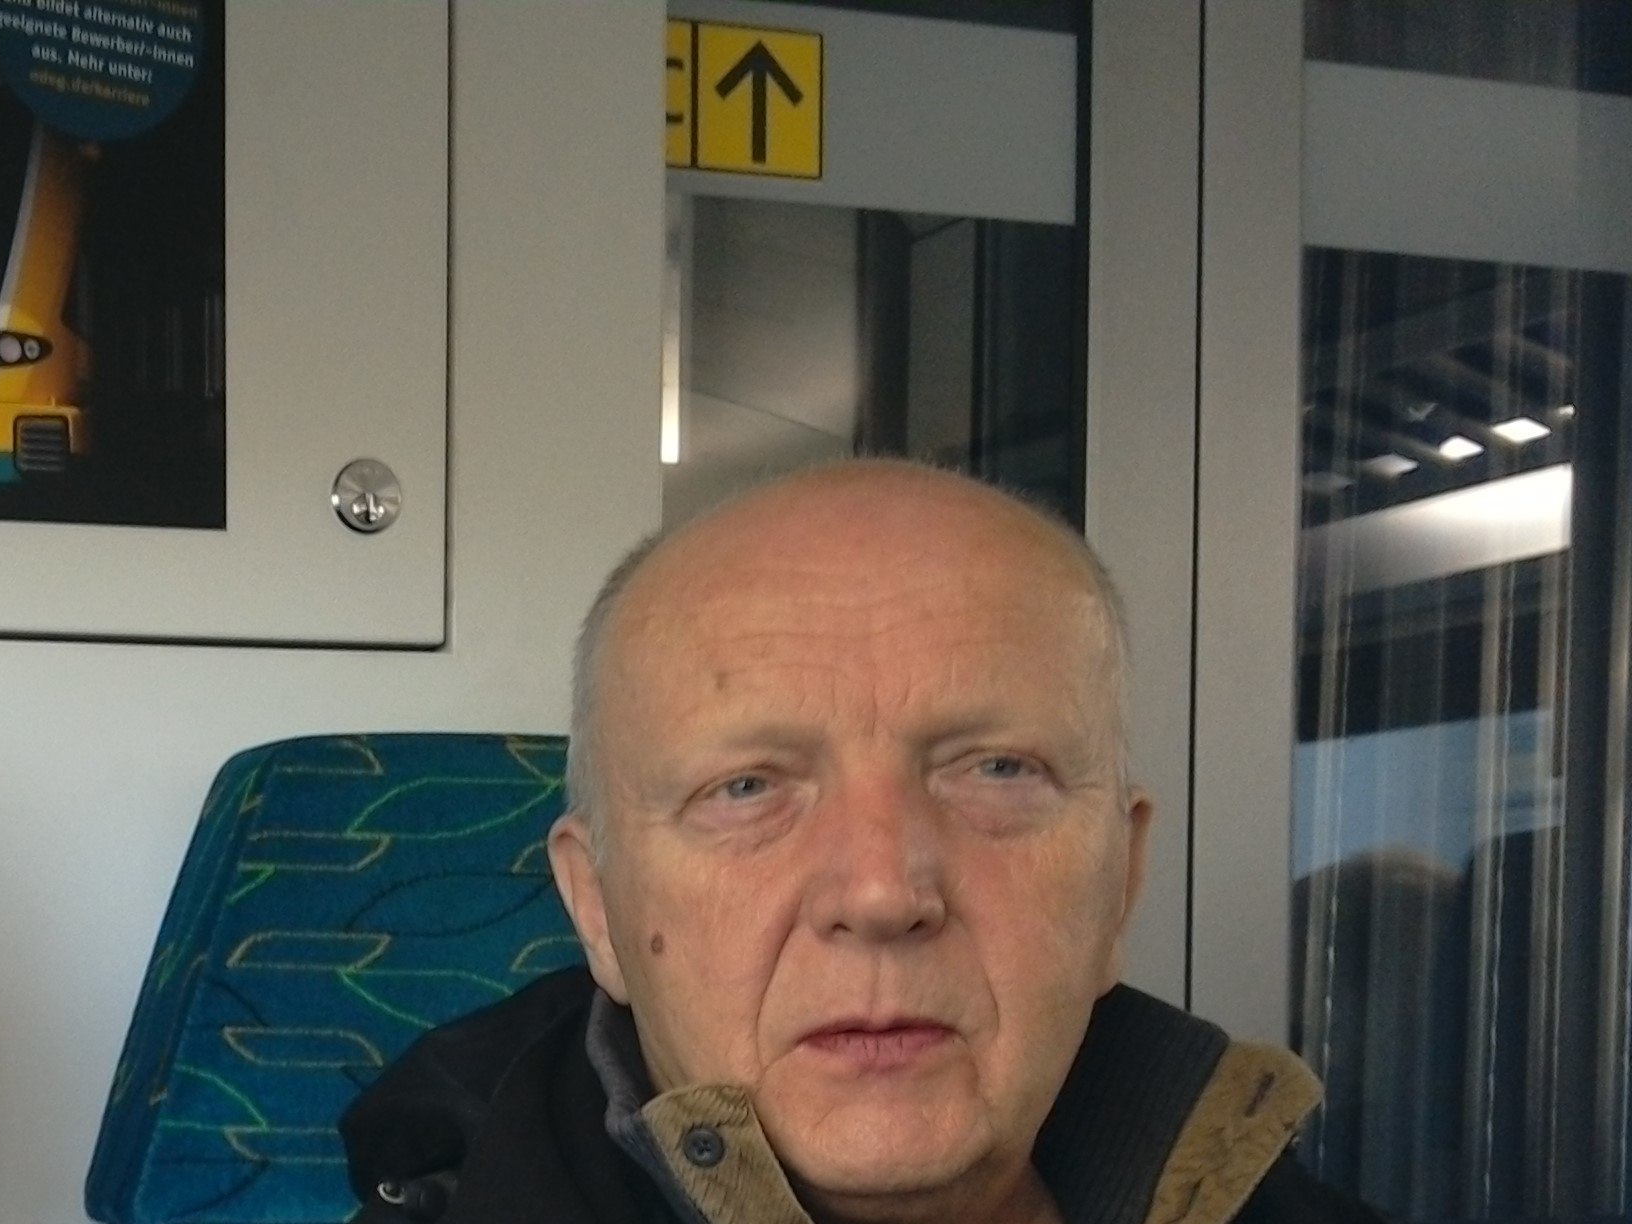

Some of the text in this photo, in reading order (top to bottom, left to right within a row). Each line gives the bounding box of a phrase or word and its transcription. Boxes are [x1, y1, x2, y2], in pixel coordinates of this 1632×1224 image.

[83, 5, 153, 34] alternativ
[158, 22, 192, 43] auch
[31, 43, 62, 63] aus.
[68, 49, 104, 72] Mehr
